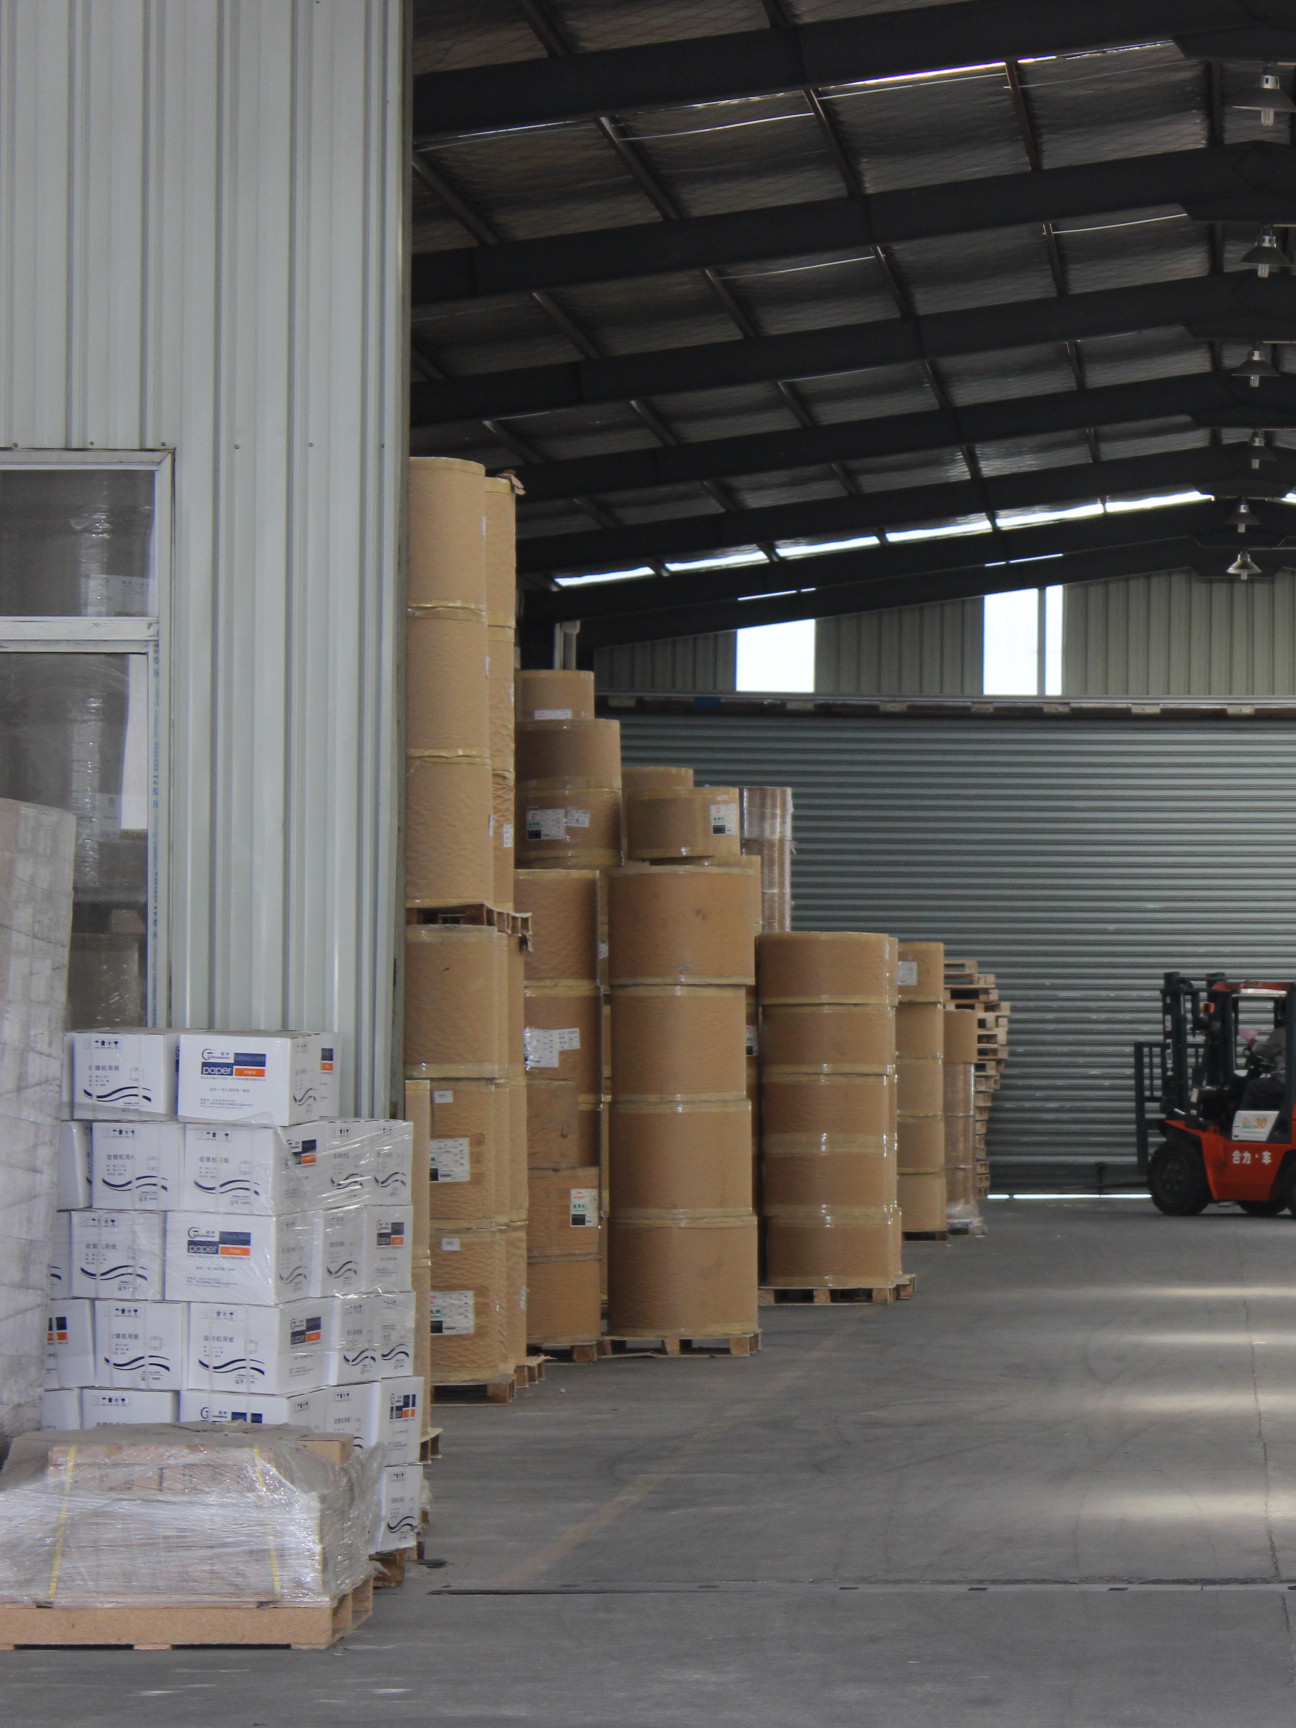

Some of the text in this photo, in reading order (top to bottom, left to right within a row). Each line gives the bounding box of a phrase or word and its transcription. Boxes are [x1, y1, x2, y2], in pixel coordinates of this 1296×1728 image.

[203, 1066, 232, 1076] paper
[1232, 1150, 1272, 1165] 合力车
[188, 1245, 217, 1254] paper
